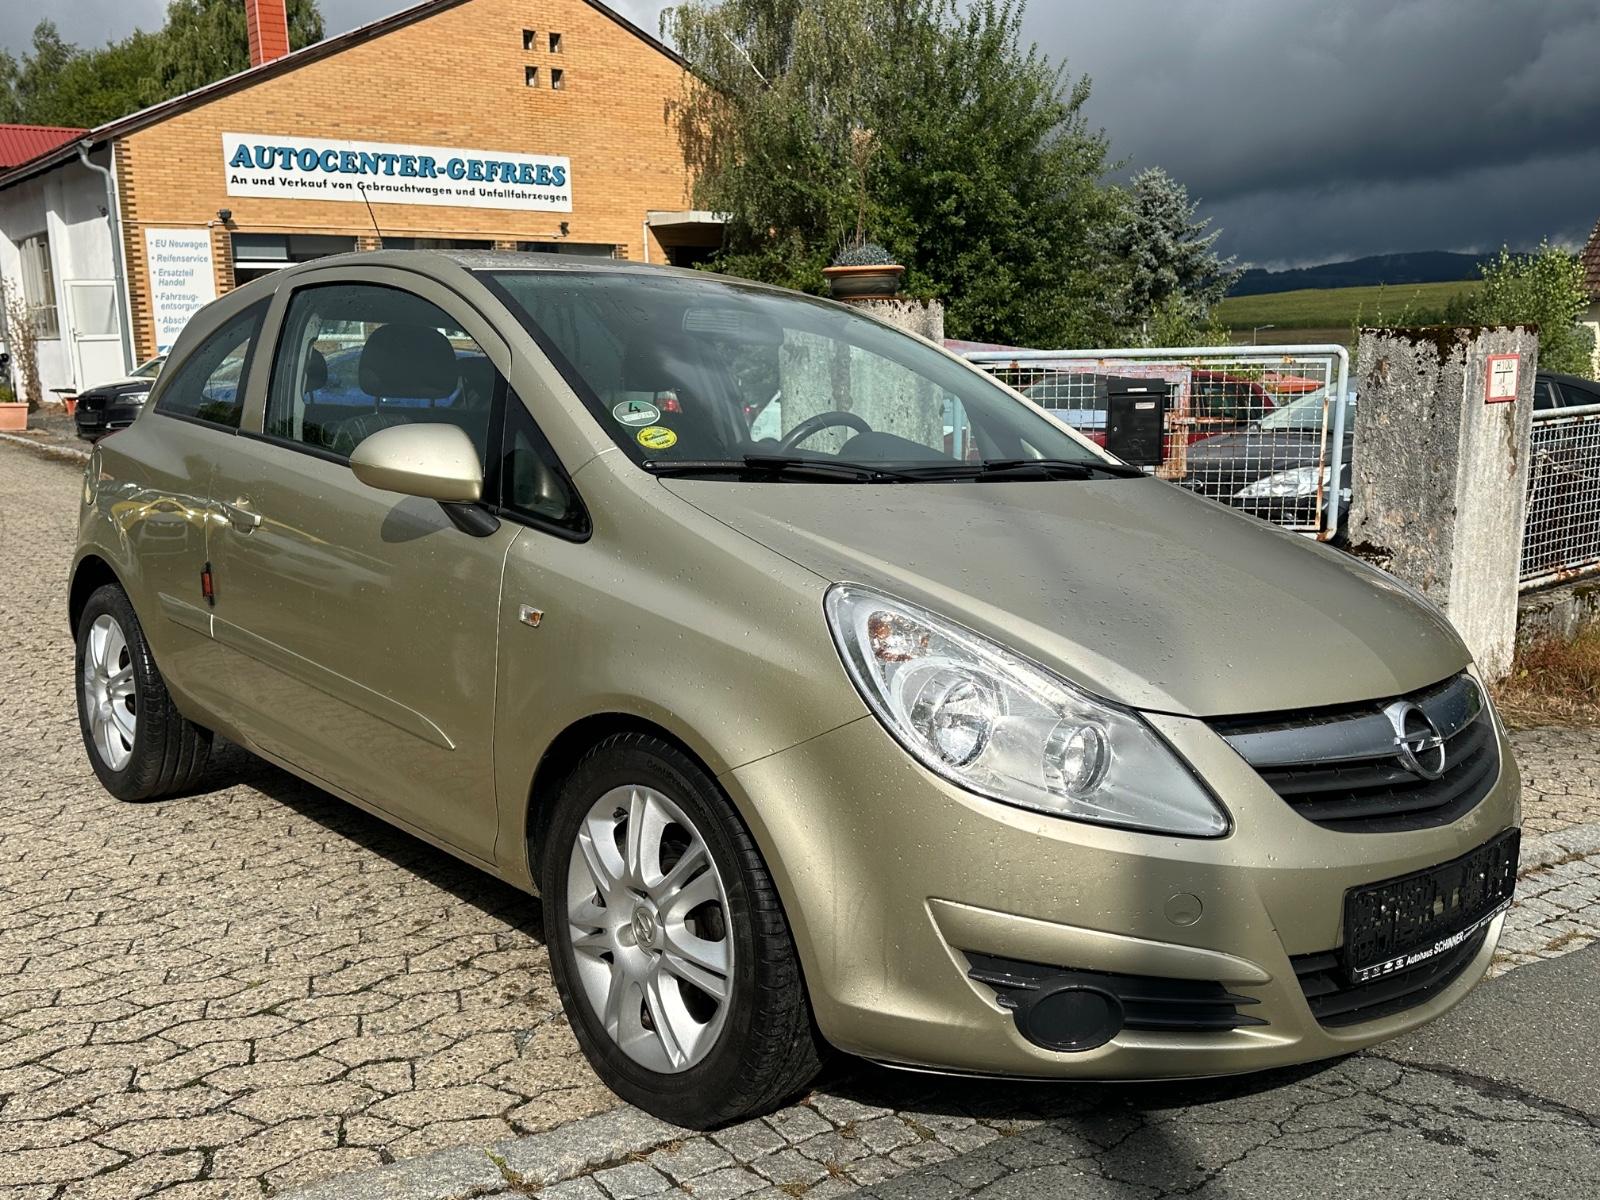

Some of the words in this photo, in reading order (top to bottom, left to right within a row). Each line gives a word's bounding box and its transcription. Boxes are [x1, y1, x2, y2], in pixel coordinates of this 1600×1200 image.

[229, 144, 566, 187] AUTOCENTER-GEFREES
[231, 175, 247, 185] An
[252, 177, 275, 186] und
[279, 177, 327, 189] Verkauf
[331, 182, 353, 190] von
[357, 181, 452, 196] Gebrauchtwagen
[456, 187, 476, 197] und
[479, 188, 568, 203] Unfallfahrzeugen
[155, 240, 167, 248] EU
[169, 240, 208, 250] Neuwagen
[156, 254, 208, 263] Reifenservice
[158, 268, 194, 277] Ersatzteil
[158, 278, 186, 287] Handel
[160, 292, 199, 302] Fahrzeug-
[1406, 949, 1433, 966] Autohaus
